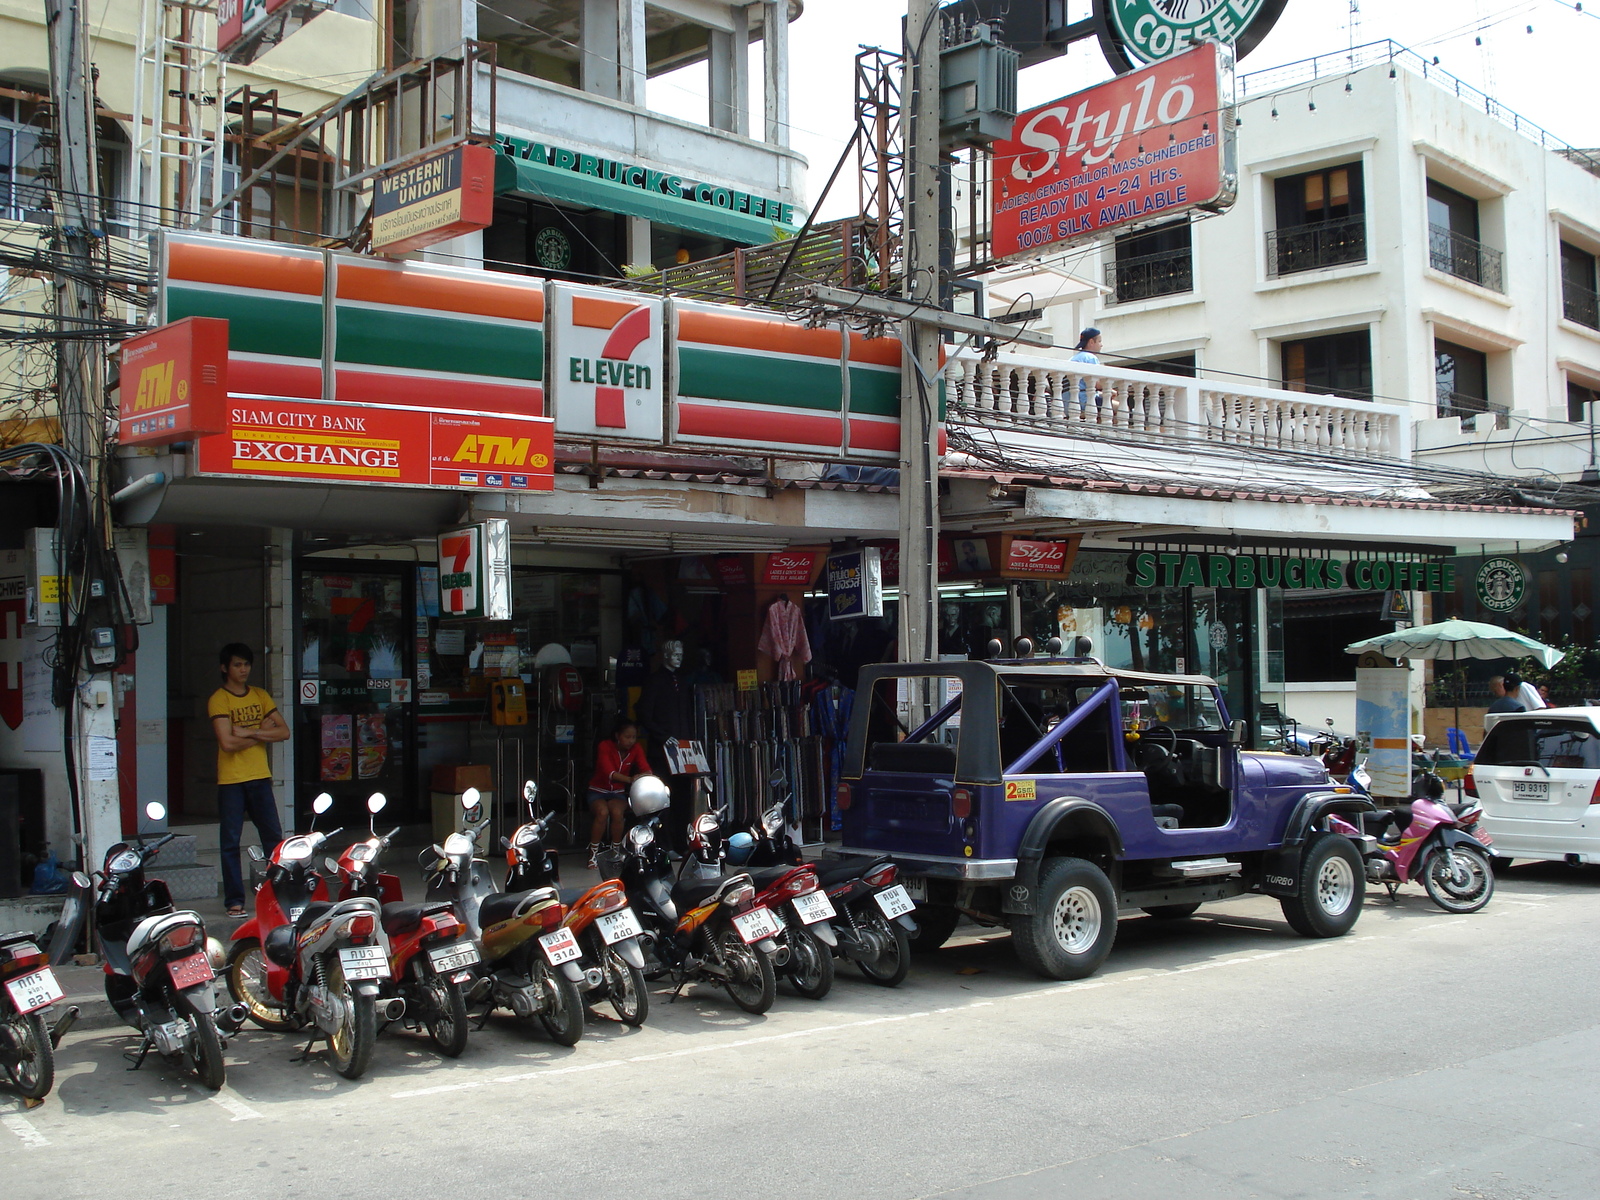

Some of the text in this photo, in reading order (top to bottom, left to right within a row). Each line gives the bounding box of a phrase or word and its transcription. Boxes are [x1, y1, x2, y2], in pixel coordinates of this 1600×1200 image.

[1011, 75, 1195, 181] Stylo
[382, 158, 442, 195] WESTERN
[490, 133, 794, 225] STARBUCKS COFFEE
[995, 190, 1030, 214] LADIES
[1035, 179, 1069, 199] GENTS
[1072, 167, 1109, 188] TAILOR
[1112, 134, 1216, 176] MASSCHNEIDEREI
[400, 175, 442, 205] UNION
[1020, 166, 1182, 226] READY IN 4-24 Hrs.
[1017, 185, 1187, 250] 100% SILK AVAILABLE
[536, 227, 570, 251] STARBUCKS
[540, 256, 566, 271] COFFEE
[572, 296, 650, 429] 7
[134, 360, 175, 412] ATM
[231, 409, 367, 432] SIAM CITY BANK
[235, 432, 296, 441] CURRENCY
[232, 440, 399, 468] EXCHANGE
[452, 434, 544, 466] ATM 24
[772, 557, 810, 569] Stylo
[1010, 544, 1063, 562] Stylo
[442, 535, 470, 611] 7
[1134, 552, 1456, 593] STARBUCKS COFFEE
[1478, 560, 1522, 583] STARBUCKS
[1483, 595, 1517, 608] COFFEE
[341, 688, 351, 696] 24
[1007, 782, 1017, 799] 2
[1529, 783, 1548, 793] 9313
[1266, 874, 1294, 886] TURBO
[809, 909, 828, 920] 955
[891, 903, 908, 915] 216
[613, 927, 633, 940] 440
[751, 926, 770, 940] 408
[554, 948, 575, 962] 314
[355, 967, 379, 977] 210
[28, 991, 52, 1008] 821
